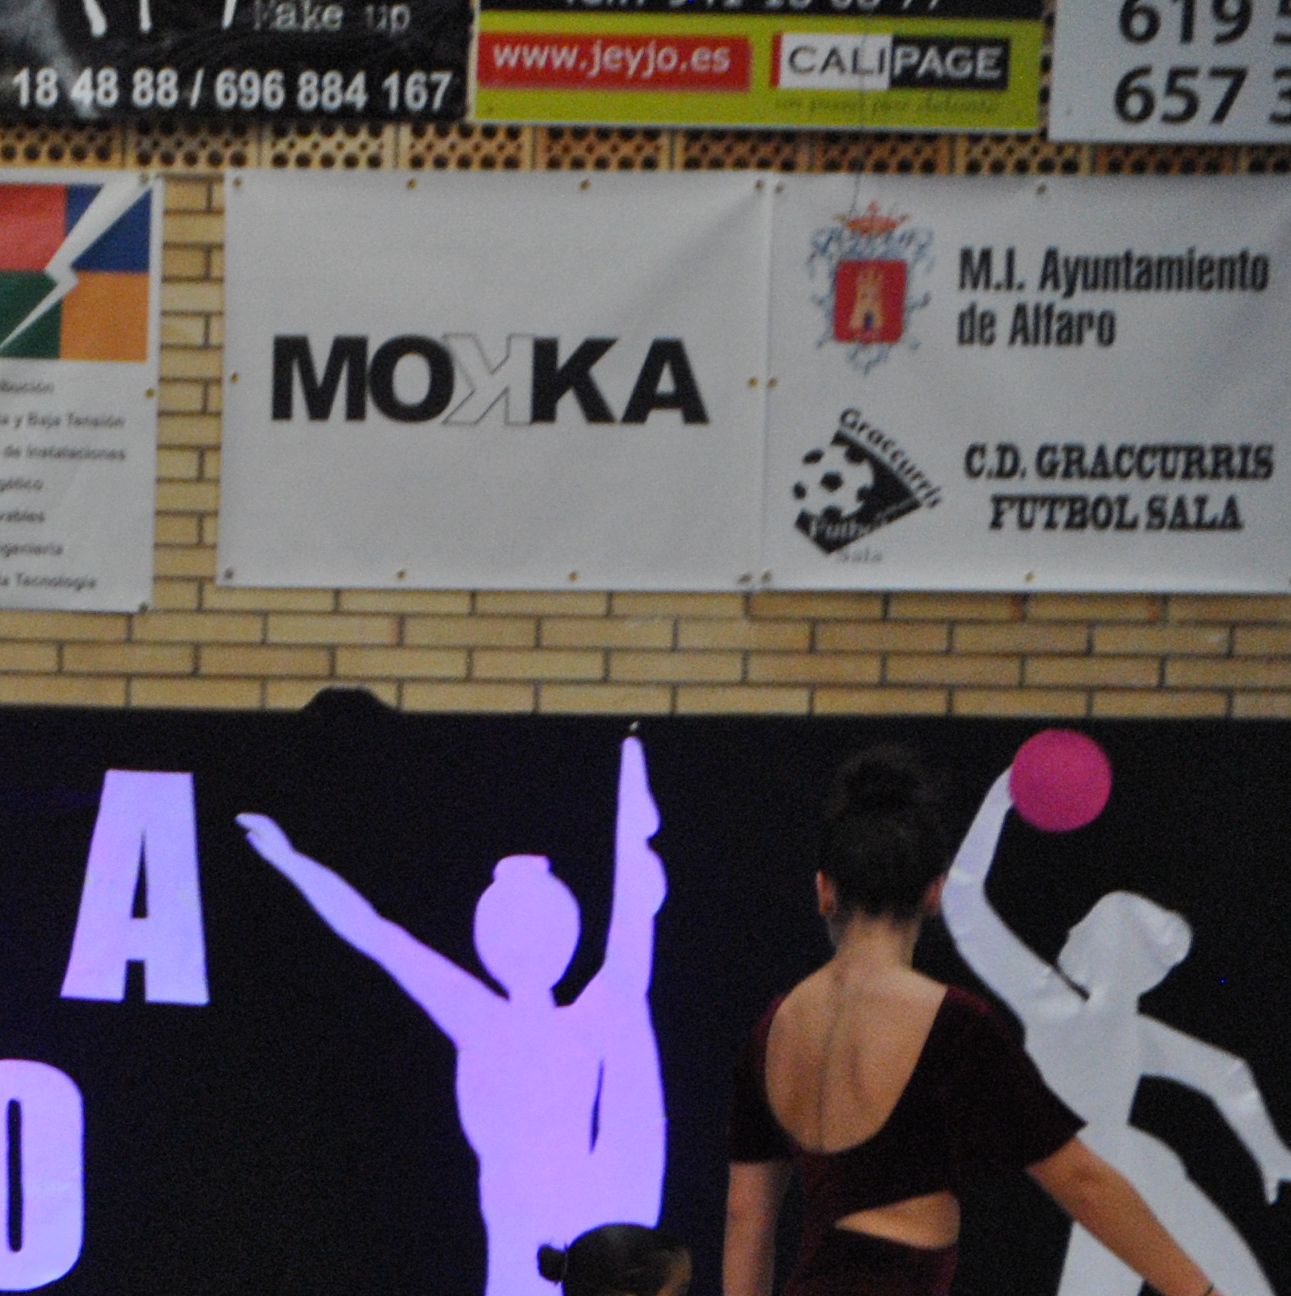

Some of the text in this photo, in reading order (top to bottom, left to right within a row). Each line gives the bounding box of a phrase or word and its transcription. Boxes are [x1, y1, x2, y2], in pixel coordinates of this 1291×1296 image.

[1119, 0, 1253, 45] 619
[492, 39, 731, 79] www.jeyjo.es
[787, 45, 1004, 80] CALIPAGE
[13, 68, 59, 108] 18
[71, 68, 119, 109] 48
[132, 69, 179, 108] 88
[188, 70, 205, 109] /
[216, 70, 286, 110] 696
[297, 70, 368, 110] 884
[382, 71, 453, 111] 167
[1114, 65, 1248, 124] 657
[1038, 246, 1270, 299] Ayuntamiento
[957, 302, 1117, 347] de Alfaro
[964, 442, 1275, 481] C.D. GRACCURRIS
[988, 493, 1245, 532] FUTBOL SALA
